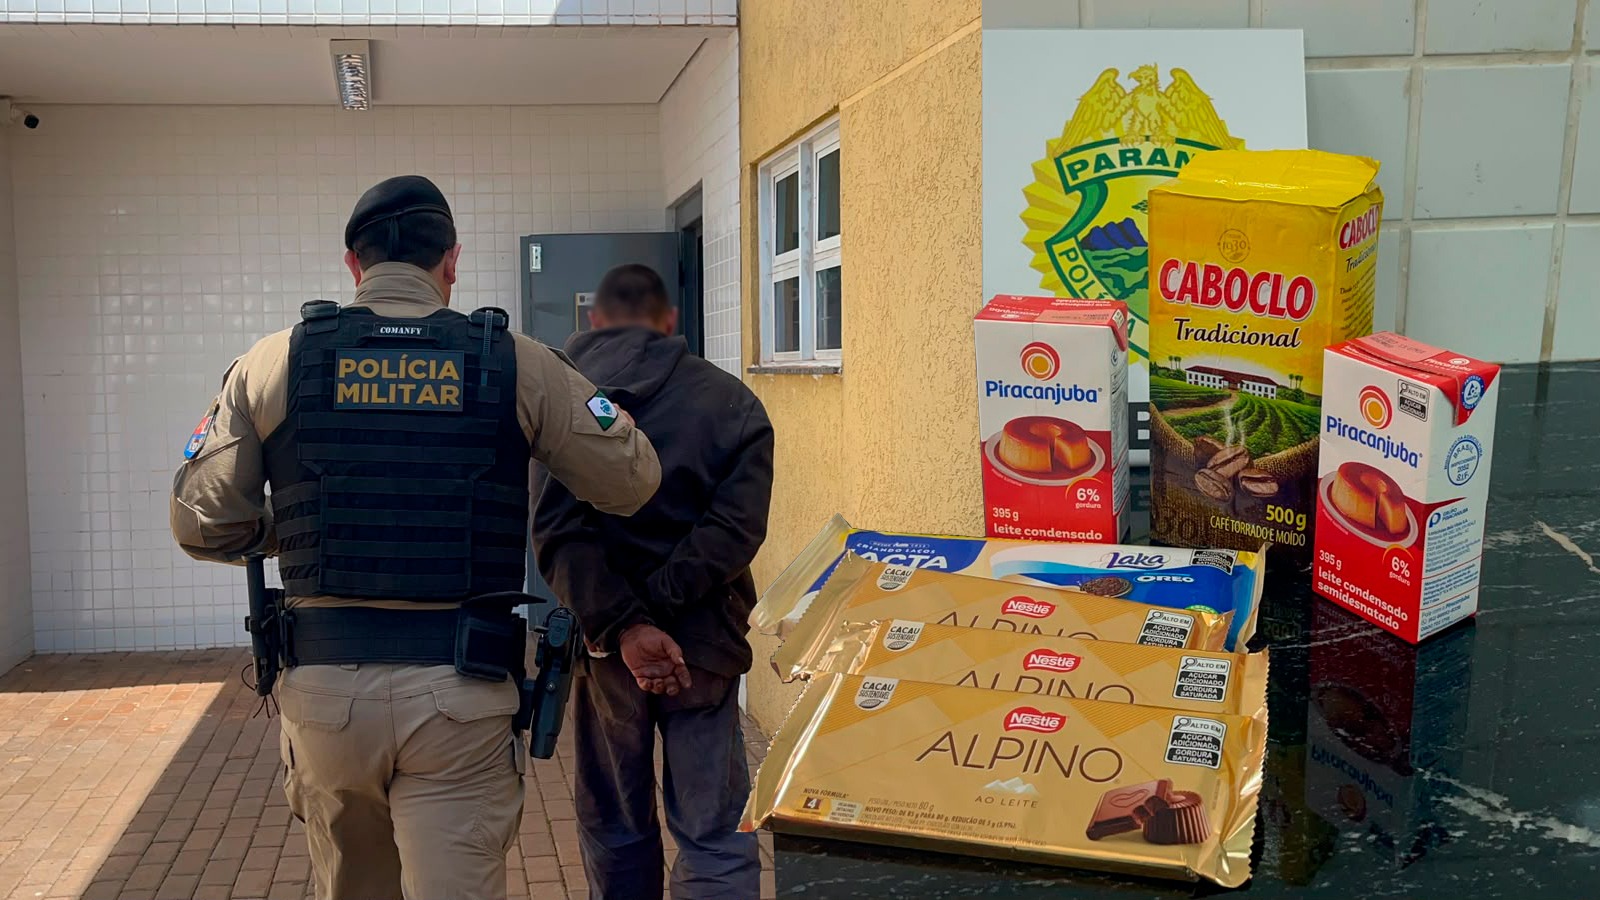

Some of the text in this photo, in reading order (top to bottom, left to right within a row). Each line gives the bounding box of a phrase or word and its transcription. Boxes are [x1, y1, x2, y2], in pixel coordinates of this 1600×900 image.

[1066, 148, 1196, 181] PARAN
[1159, 258, 1315, 321] CABOCLO
[1173, 318, 1301, 348] Tradicional
[338, 354, 460, 381] POLÍCIA
[337, 383, 460, 406] MILITAR
[985, 380, 1099, 405] Piracanjuba
[1326, 415, 1419, 469] Piracanjuba
[1076, 487, 1100, 502] 6%
[1075, 501, 1102, 509] gordura
[993, 523, 1103, 540] leite condensado
[1210, 514, 1306, 547] CAFÉ TORRADO E MOÍDO
[859, 551, 948, 569] ACTA
[1106, 552, 1165, 570] Laka
[1391, 556, 1410, 577] 6%
[884, 568, 912, 577] CACAU
[1137, 575, 1195, 583] OREO
[1389, 571, 1411, 586] gordura
[1318, 566, 1342, 586] leite
[1343, 582, 1408, 621] condensado
[1007, 600, 1051, 615] Nestlé
[1317, 581, 1400, 630] semidesnatado
[890, 626, 920, 635] CACAU
[1145, 629, 1185, 640] ADICIONADO
[1145, 636, 1179, 646] GORDURA
[1029, 654, 1076, 668] Nestlé
[862, 682, 895, 692] CACAU
[1180, 677, 1224, 687] ADICIONADO
[1182, 685, 1218, 694] GORDURA
[1180, 691, 1218, 700] SATURADA
[1010, 713, 1061, 729] Nestlé
[1210, 725, 1221, 733] EM
[1172, 740, 1219, 751] ADICIONADO
[915, 730, 1123, 783] ALPINO
[1172, 755, 1213, 765] SATURADA
[1175, 749, 1213, 759] GORDURA
[807, 798, 818, 809] 4
[975, 795, 1039, 809] AO LEITE
[920, 812, 935, 820] PARA
